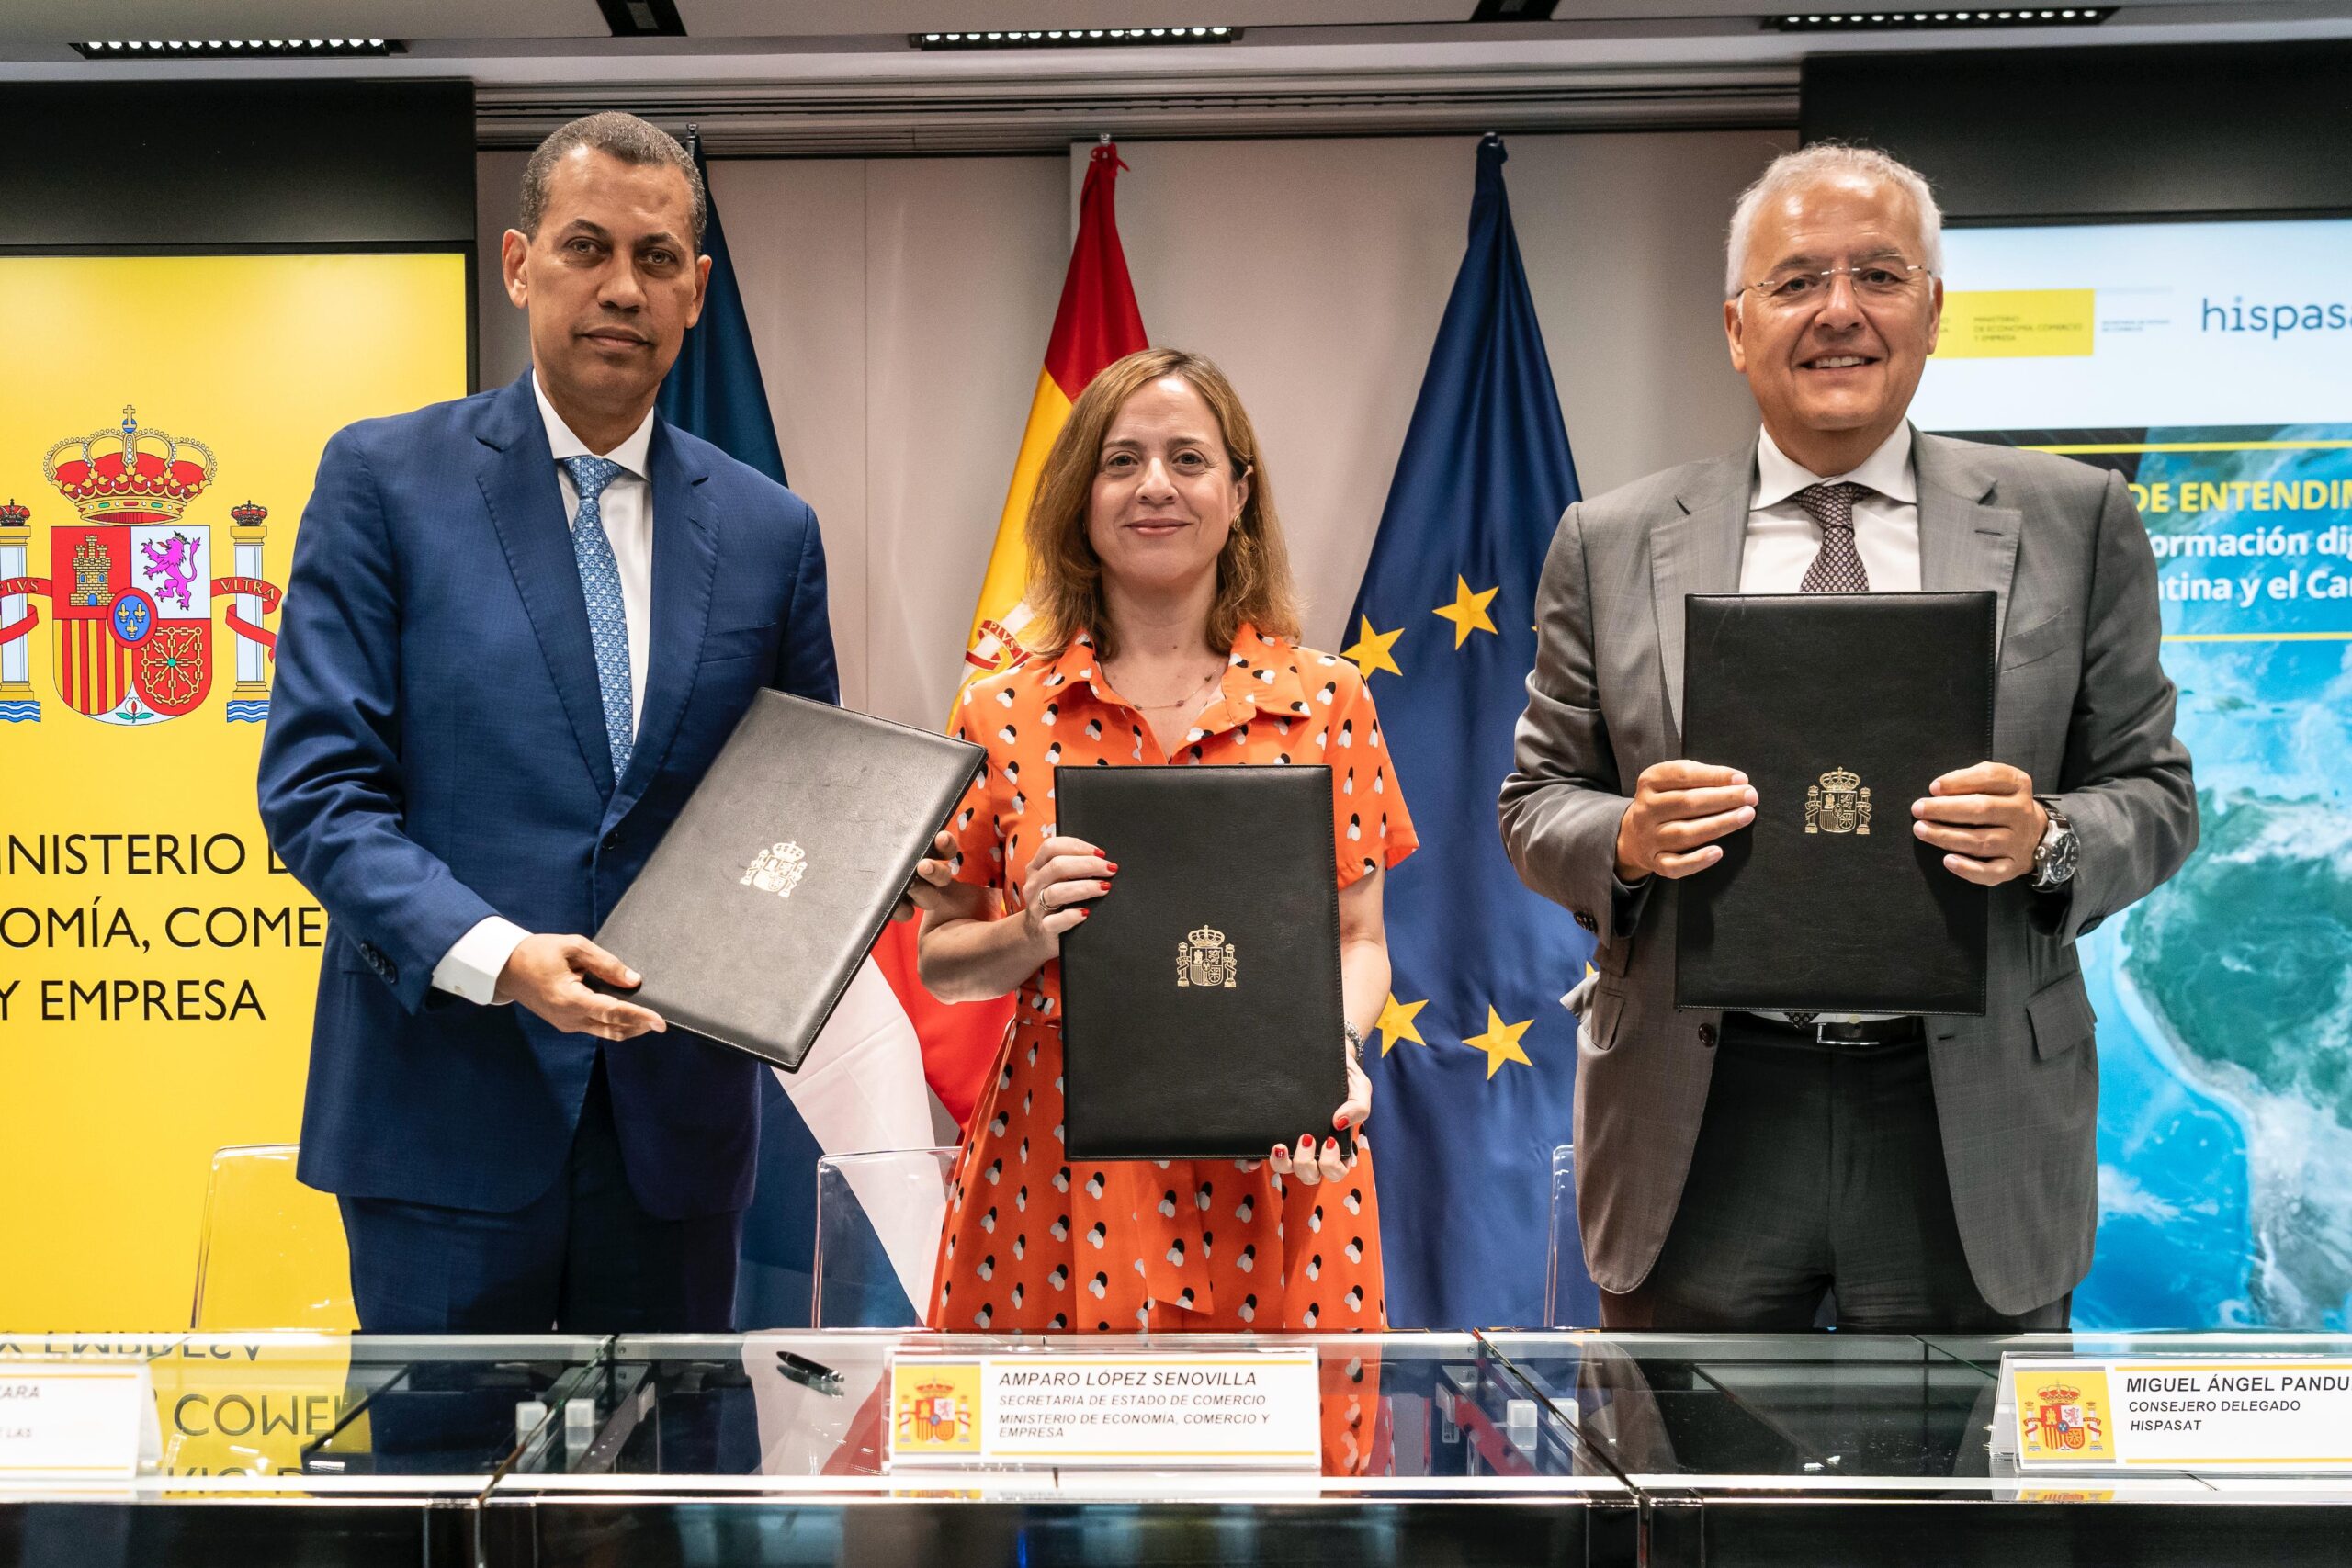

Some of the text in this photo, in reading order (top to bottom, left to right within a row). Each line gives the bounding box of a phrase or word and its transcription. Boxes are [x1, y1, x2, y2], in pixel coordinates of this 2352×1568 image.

[2202, 295, 2352, 340] hispas
[2145, 525, 2309, 558] ormación
[220, 579, 276, 600] VLTRA
[2159, 570, 2352, 608] tina y el Ca
[0, 832, 246, 875] NISTERIO
[0, 895, 322, 954] OMÍA, COME
[0, 979, 266, 1021] Y EMPRESA
[999, 1369, 1257, 1386] AMPARO LÓPEZ SENOVILLA
[2126, 1373, 2350, 1393] MIGUEL ÁNGEL PANDU
[0, 1385, 39, 1399] ARA
[999, 1394, 1266, 1405] SECRETARIA DE ESTADO DE COMERCIO
[2129, 1400, 2301, 1413] CONSEJERO DELEGADO
[999, 1414, 1076, 1425] MINISTERIO
[1080, 1414, 1099, 1425] DE
[1183, 1414, 1257, 1425] COMERCIO
[1261, 1414, 1270, 1424] Y
[2130, 1419, 2202, 1431] HISPASAT
[999, 1427, 1064, 1438] EMPRESA
